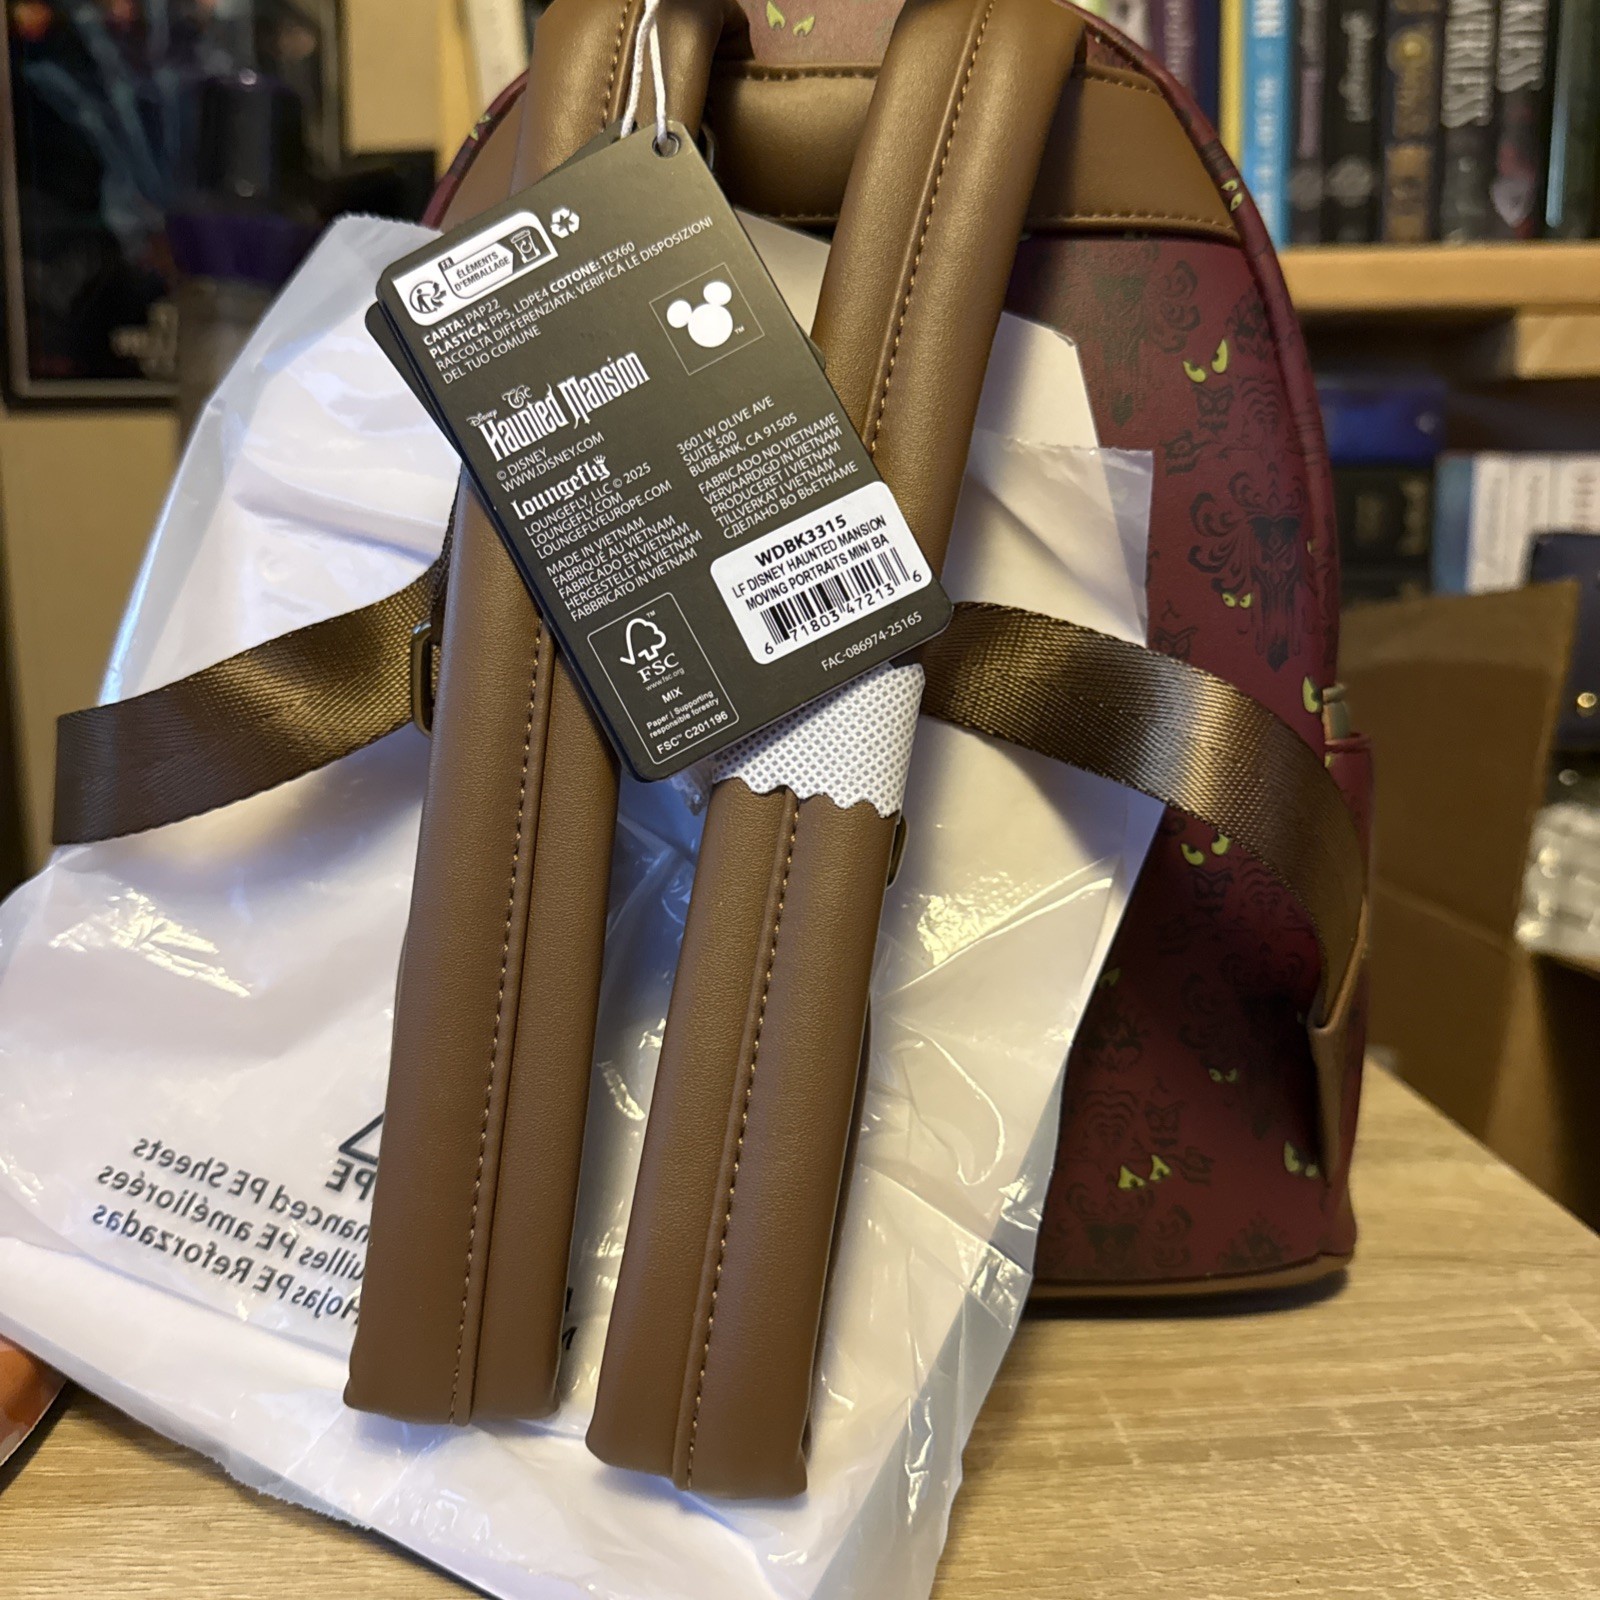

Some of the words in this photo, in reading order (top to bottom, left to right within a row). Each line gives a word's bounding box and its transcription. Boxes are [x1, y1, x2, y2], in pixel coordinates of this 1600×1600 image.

[435, 335, 493, 371] RACCOLTA
[492, 290, 577, 340] DIFFERENZIATA:
[575, 263, 625, 294] VERIFICA
[624, 254, 640, 269] LE
[639, 215, 713, 261] DISPOSIZIONI
[440, 257, 454, 269] FR
[454, 256, 509, 291] D'EMBALLAGE
[456, 251, 498, 279] ÉLÉMENTS
[423, 319, 466, 345] CARTA:
[464, 298, 500, 323] PAP22
[429, 321, 489, 358] PLASTICA:
[488, 308, 514, 326] PP5,
[513, 287, 548, 313] LDPE4
[549, 261, 601, 292] COTONE:
[599, 241, 634, 265] TEX60
[442, 366, 466, 384] DEL
[464, 352, 490, 371] TUO
[490, 324, 541, 357] COMUNE
[466, 409, 497, 428] Disney
[478, 384, 569, 461] Haunted
[556, 352, 650, 428] Mansion
[501, 384, 532, 408] The
[676, 433, 703, 454] 3601
[703, 425, 716, 438] W
[717, 407, 751, 431] OLIVE
[752, 395, 774, 414] AVE
[500, 431, 604, 492] WWW.DISNEY.COM
[506, 446, 546, 476] DISNEY
[682, 441, 715, 465] SUITE
[715, 430, 736, 448] 500
[688, 441, 746, 477] BURBANK,
[745, 431, 763, 446] CA
[762, 412, 797, 437] 91505
[697, 453, 761, 494] FABRICADO
[761, 443, 781, 459] NO
[779, 412, 838, 449] VIETNAME
[703, 458, 780, 504] VERVAARDIGD
[779, 451, 793, 464] IN
[791, 425, 842, 457] VIETNAM
[510, 454, 610, 519] loungefly
[524, 494, 591, 536] LOUNGEFLY,
[590, 482, 612, 501] LLC
[622, 461, 650, 483] 2025
[710, 470, 782, 516] PRODUCERET
[783, 467, 790, 477] I
[788, 440, 840, 473] VIETNAM
[715, 487, 778, 527] TILLVERKAT
[778, 484, 785, 494] I
[783, 457, 835, 491] VIETNAM
[530, 491, 623, 547] LOUNGEFLY.COM
[536, 479, 672, 559] LOUNGEFLYEUROPE.COM
[723, 503, 779, 538] СДЕЛАНО
[778, 493, 796, 509] ВО
[754, 514, 846, 566] WDBK3315
[546, 550, 581, 576] MADE
[580, 543, 595, 557] IN
[593, 516, 645, 549] VIETNAM
[551, 550, 607, 587] FABRIQUÉ
[608, 541, 624, 558] AU
[623, 514, 675, 547] VIETNAM
[558, 558, 621, 599] FABRICADO
[621, 549, 639, 564] EN
[637, 521, 689, 555] VIETNAM
[564, 563, 636, 610] HERGESTELLT
[637, 556, 652, 571] IN
[650, 529, 702, 562] VIETNAM
[731, 582, 745, 598] LF
[746, 563, 785, 591] DISNEY
[785, 538, 837, 571] HAUNTED
[836, 514, 886, 546] MANSION
[745, 581, 788, 610] MOVING
[787, 552, 848, 589] PORTRAITS
[847, 540, 871, 560] MINI
[870, 533, 889, 549] BA
[570, 580, 635, 621] FABBRICATO
[634, 573, 649, 587] IN
[646, 547, 697, 579] VIETNAM
[764, 641, 773, 654] 6
[789, 609, 839, 641] 71803
[846, 582, 894, 613] 47213
[912, 569, 922, 582] 6
[637, 652, 678, 683] FSC
[820, 610, 921, 671] FAC-086974-25165
[645, 667, 685, 691] www.fsc.org
[661, 686, 682, 703] MIX
[646, 713, 668, 729] Paper
[673, 690, 713, 714] Supporting
[649, 713, 690, 738] responsible
[690, 696, 718, 715] forestry
[684, 710, 728, 739] C201196
